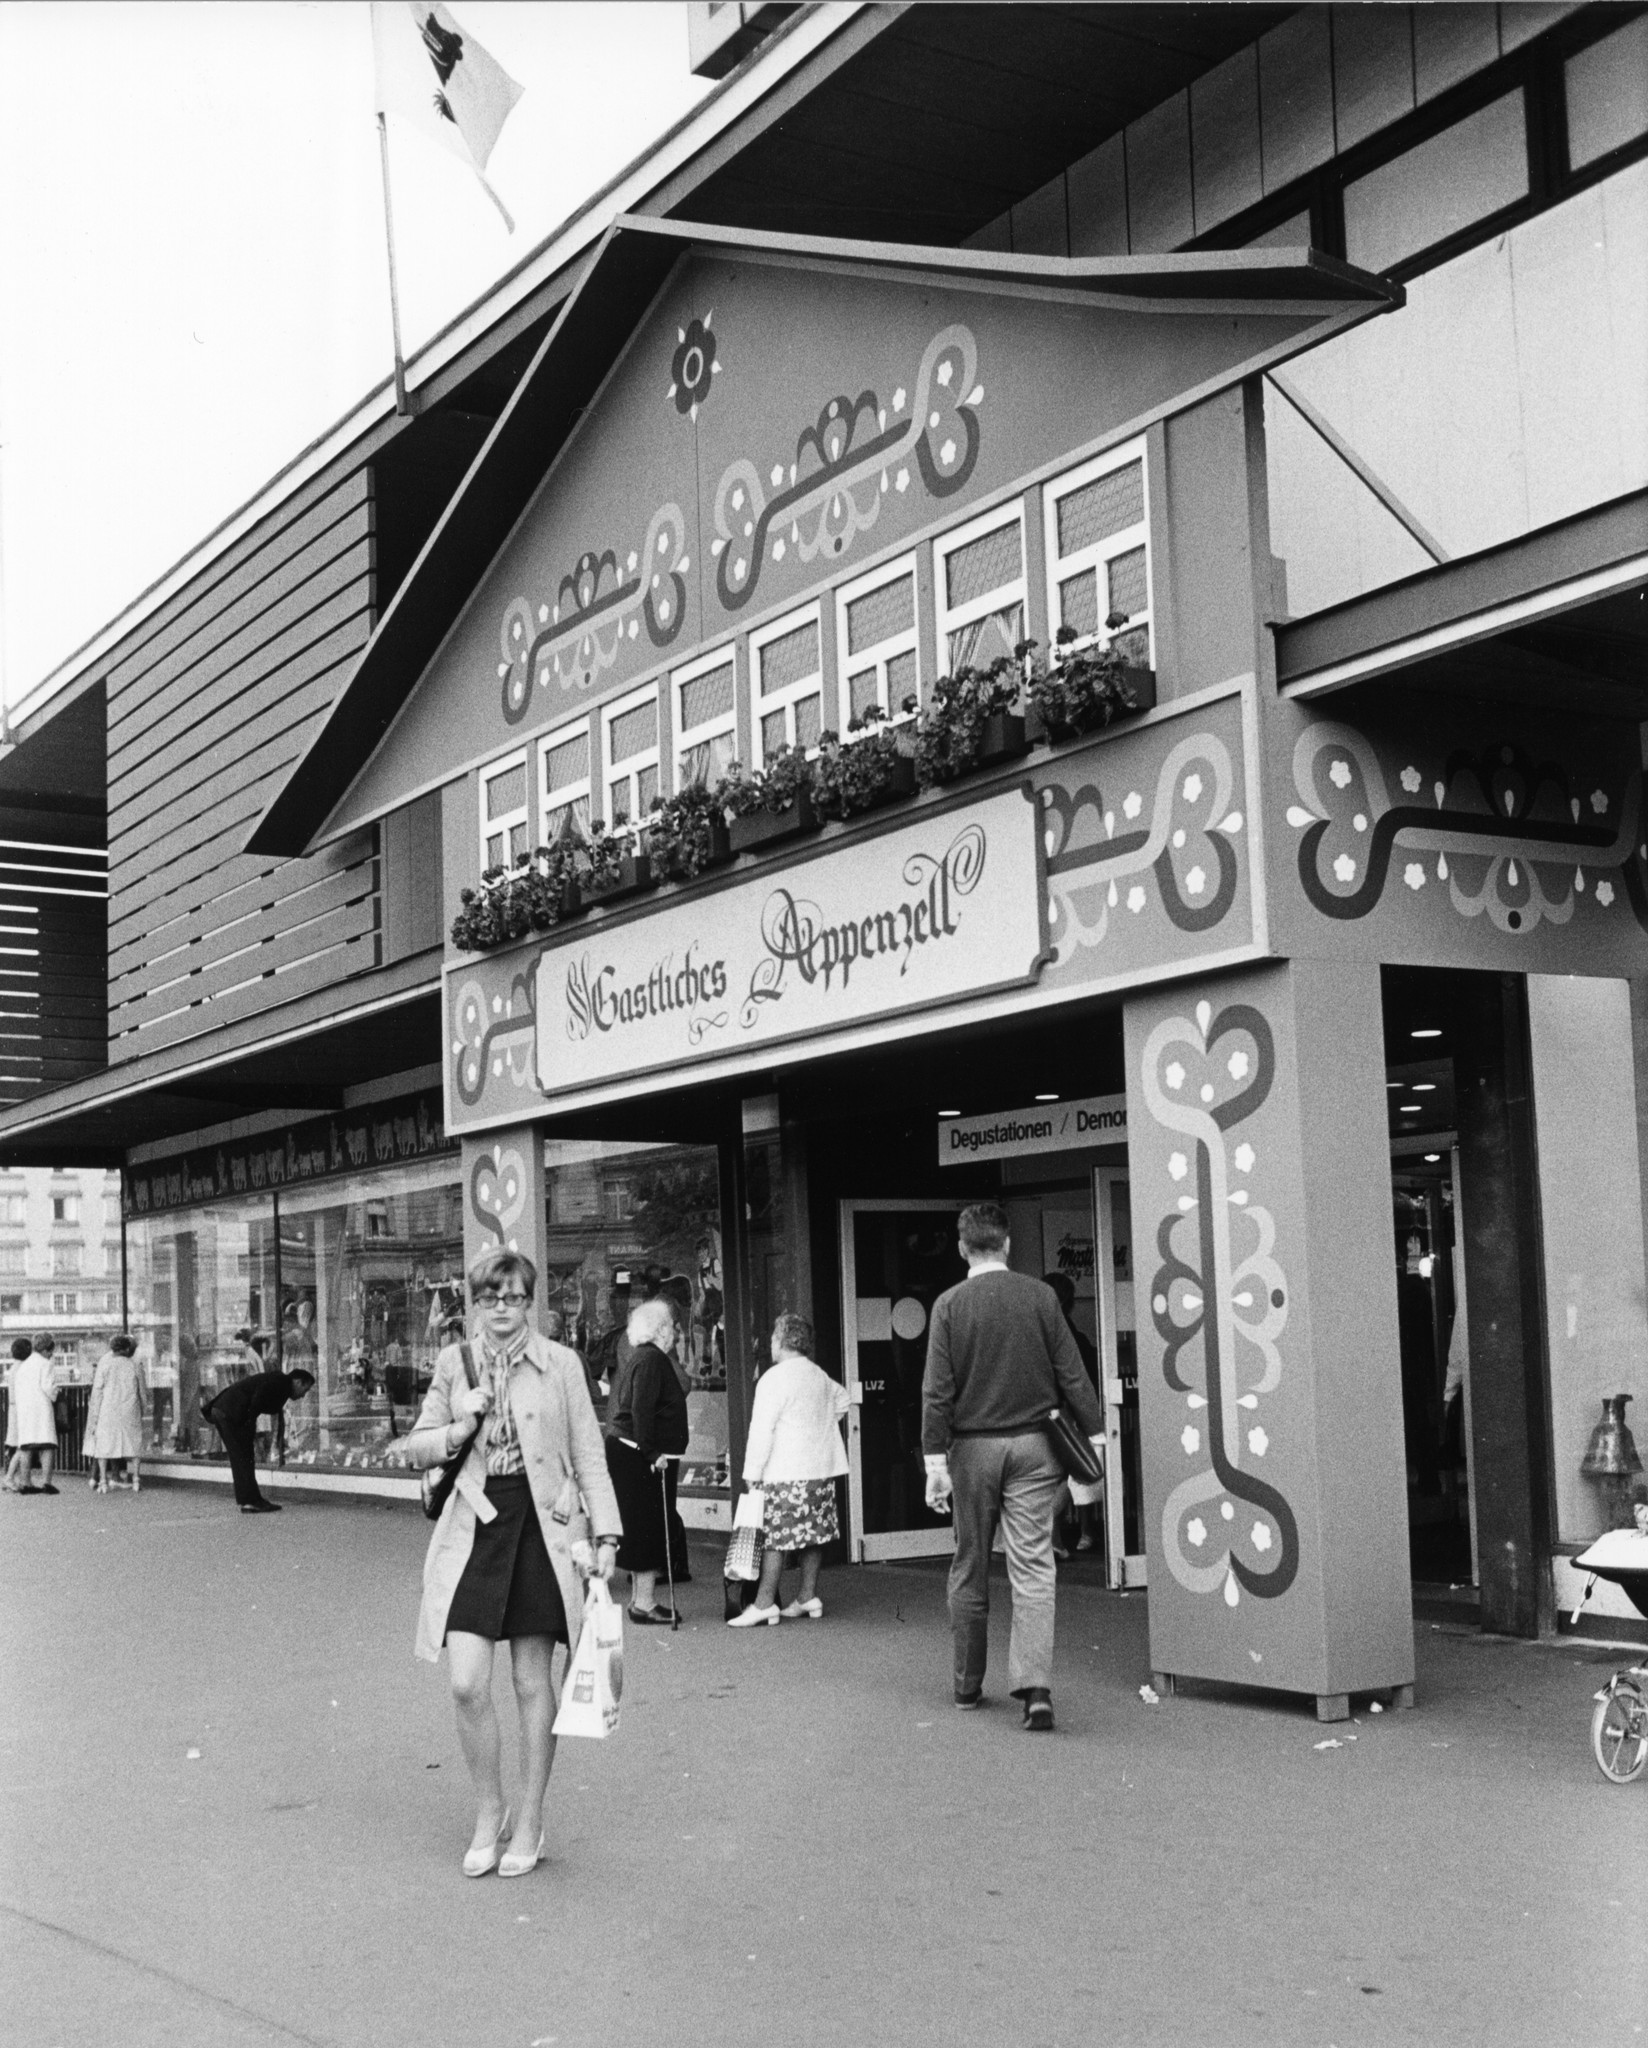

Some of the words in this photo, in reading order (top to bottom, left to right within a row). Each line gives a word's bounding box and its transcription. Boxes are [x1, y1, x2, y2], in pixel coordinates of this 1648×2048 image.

[566, 939, 730, 1045] Gastliches
[740, 824, 986, 1029] Appenzell
[951, 1120, 1052, 1151] Degustationen
[865, 1380, 885, 1391] LVZ
